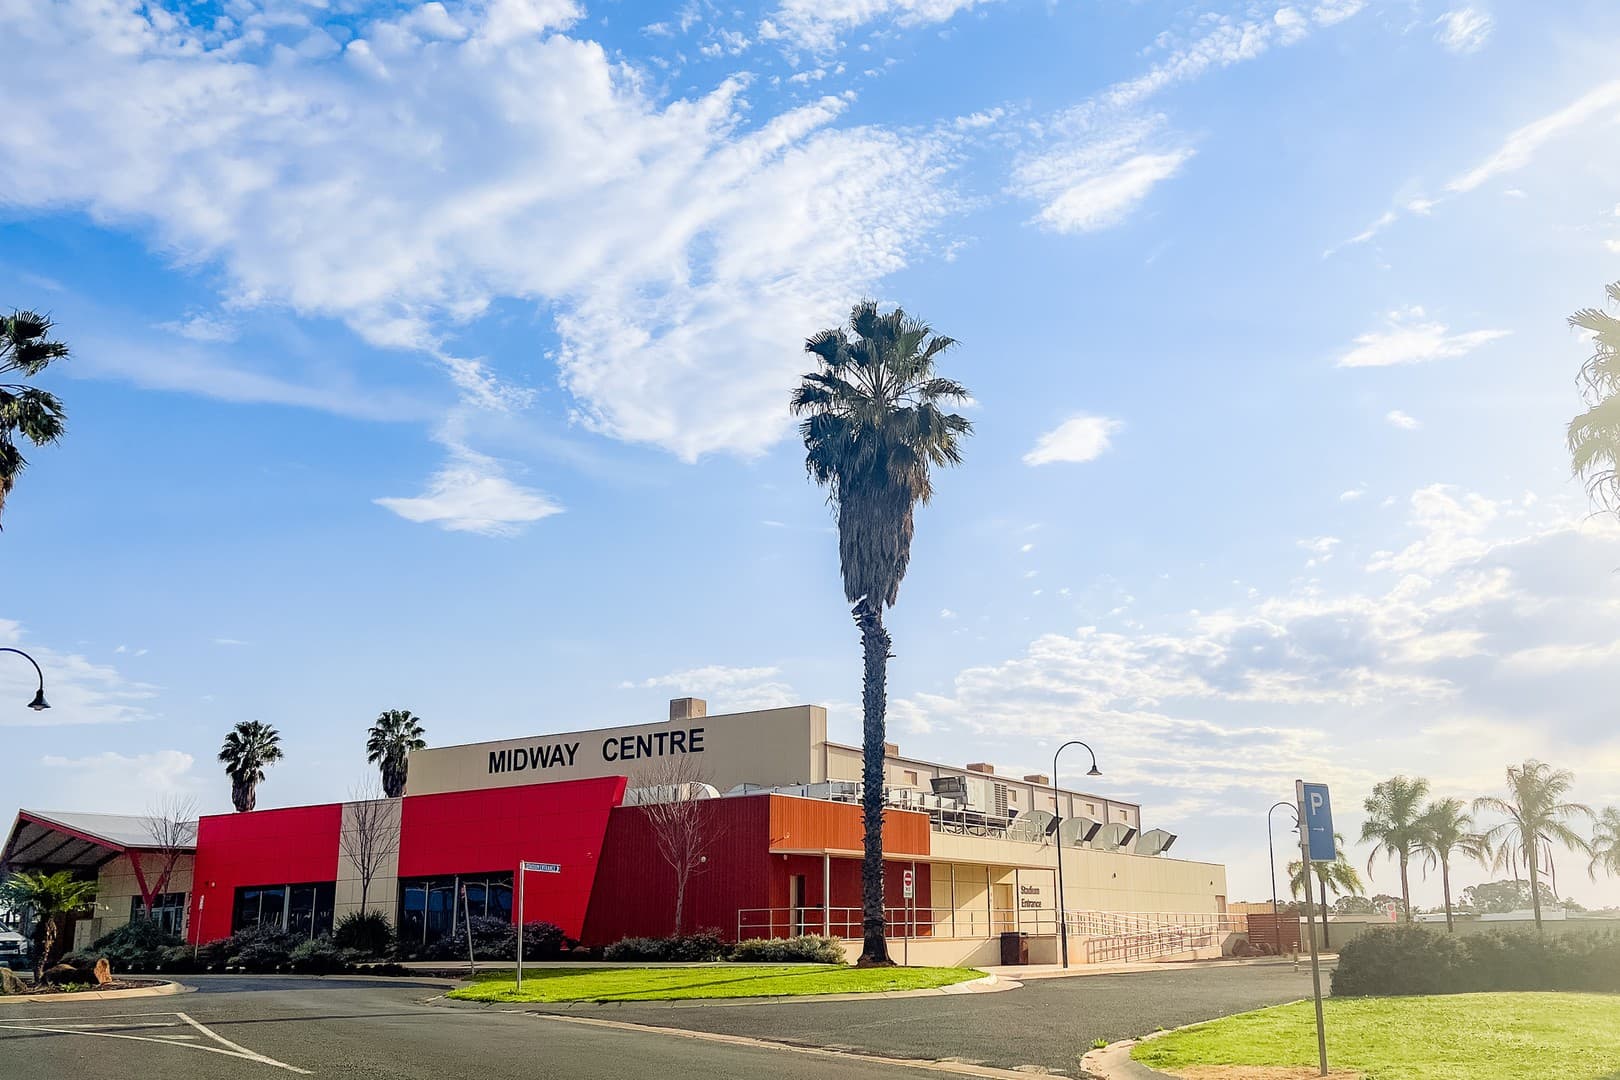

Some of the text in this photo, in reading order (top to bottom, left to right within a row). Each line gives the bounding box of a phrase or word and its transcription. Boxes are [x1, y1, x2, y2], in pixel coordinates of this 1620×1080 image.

[489, 728, 704, 774] MIDWAY CENTRE
[1310, 792, 1323, 816] P
[1021, 898, 1042, 908] Entrance
